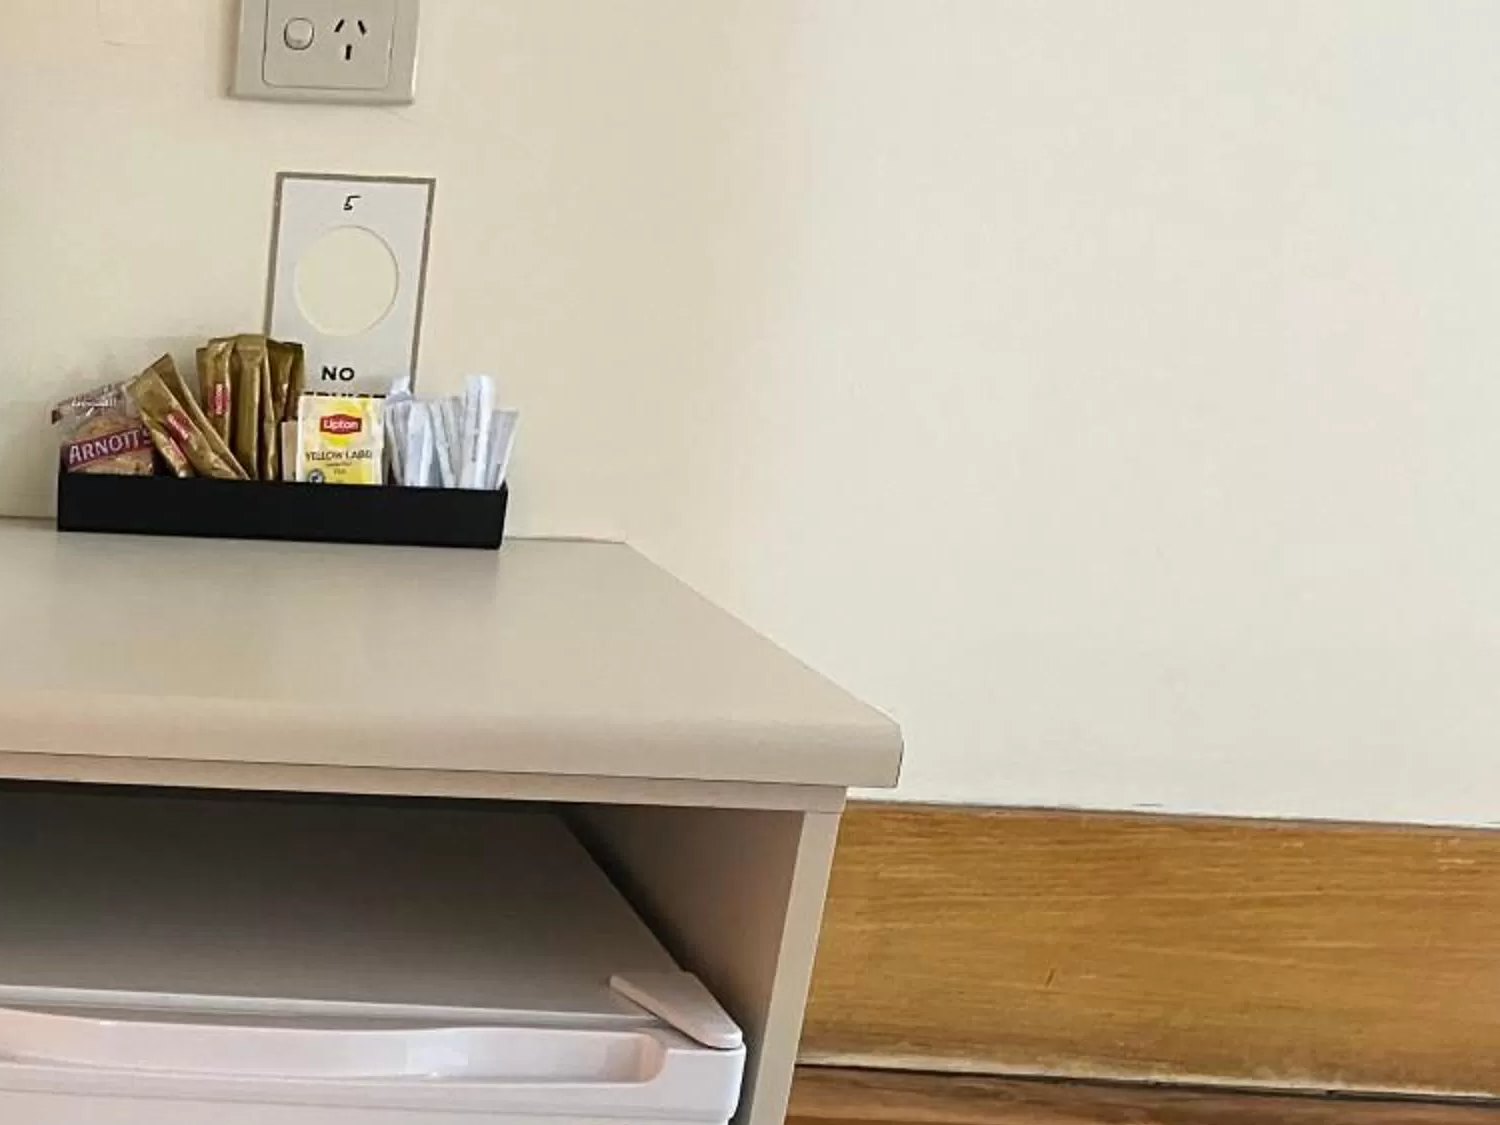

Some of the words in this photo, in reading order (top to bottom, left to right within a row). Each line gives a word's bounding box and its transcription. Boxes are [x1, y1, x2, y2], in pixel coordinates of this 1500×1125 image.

[321, 366, 355, 381] NO
[323, 418, 359, 433] Lipton
[305, 451, 343, 461] YELLOW
